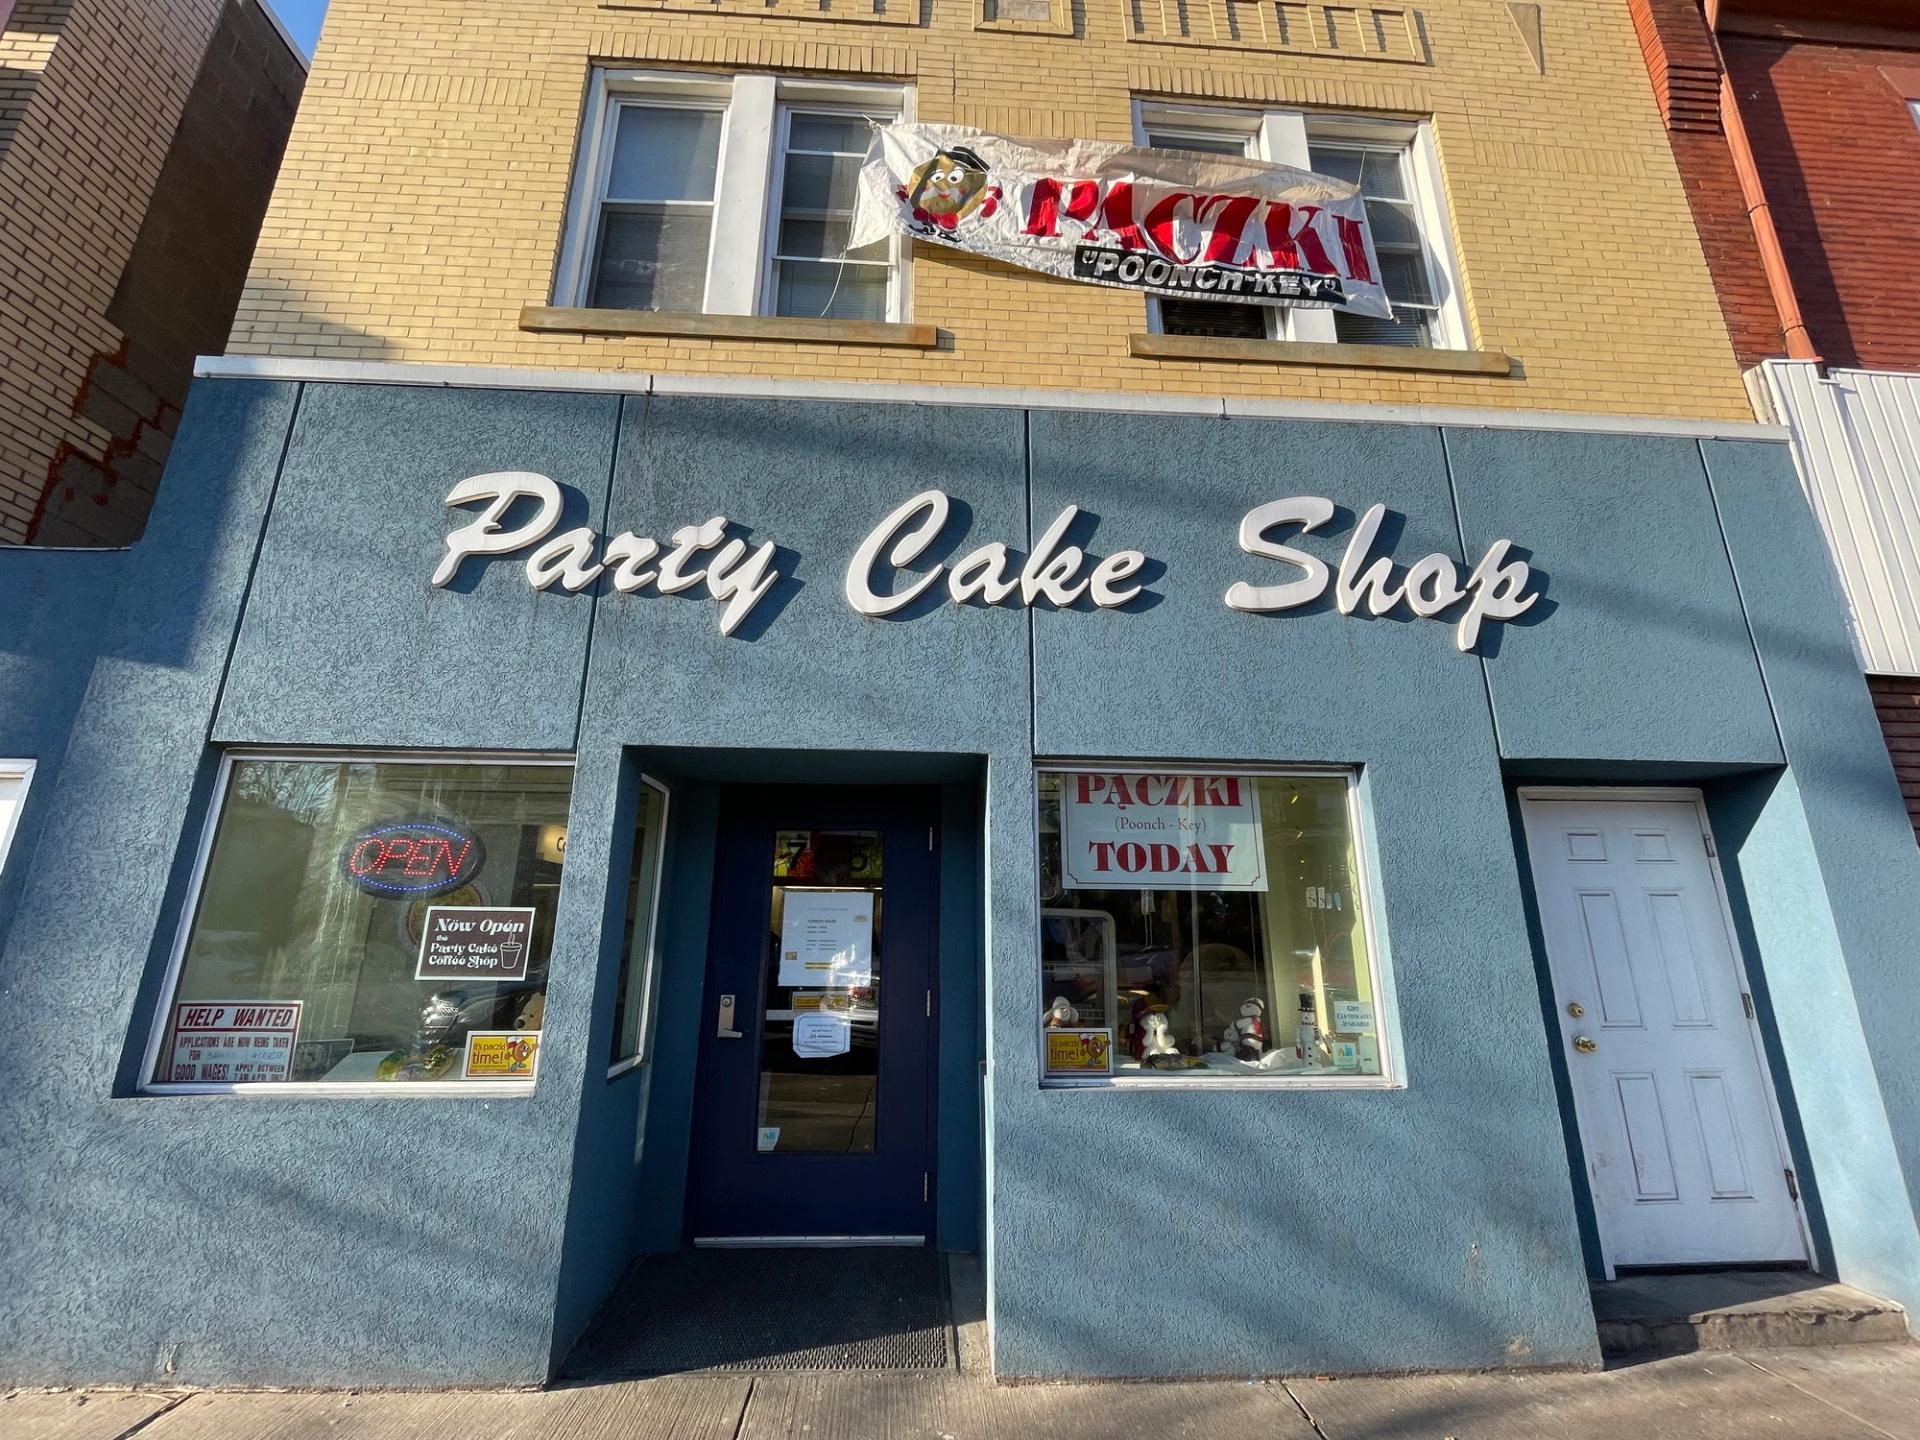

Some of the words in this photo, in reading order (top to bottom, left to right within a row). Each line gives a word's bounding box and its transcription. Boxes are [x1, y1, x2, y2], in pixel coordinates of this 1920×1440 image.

[1082, 250, 1335, 297] "POONCH-KEY"
[431, 471, 778, 636] Party
[846, 489, 1145, 617] Cake
[1224, 496, 1539, 652] Shop
[350, 837, 472, 876] OPEN
[1088, 841, 1235, 874] TODAY
[430, 943, 466, 955] Party
[183, 1009, 225, 1027] HELP
[233, 1009, 294, 1027] WANTED
[472, 1051, 504, 1065] time!
[175, 1064, 196, 1081] GOOD
